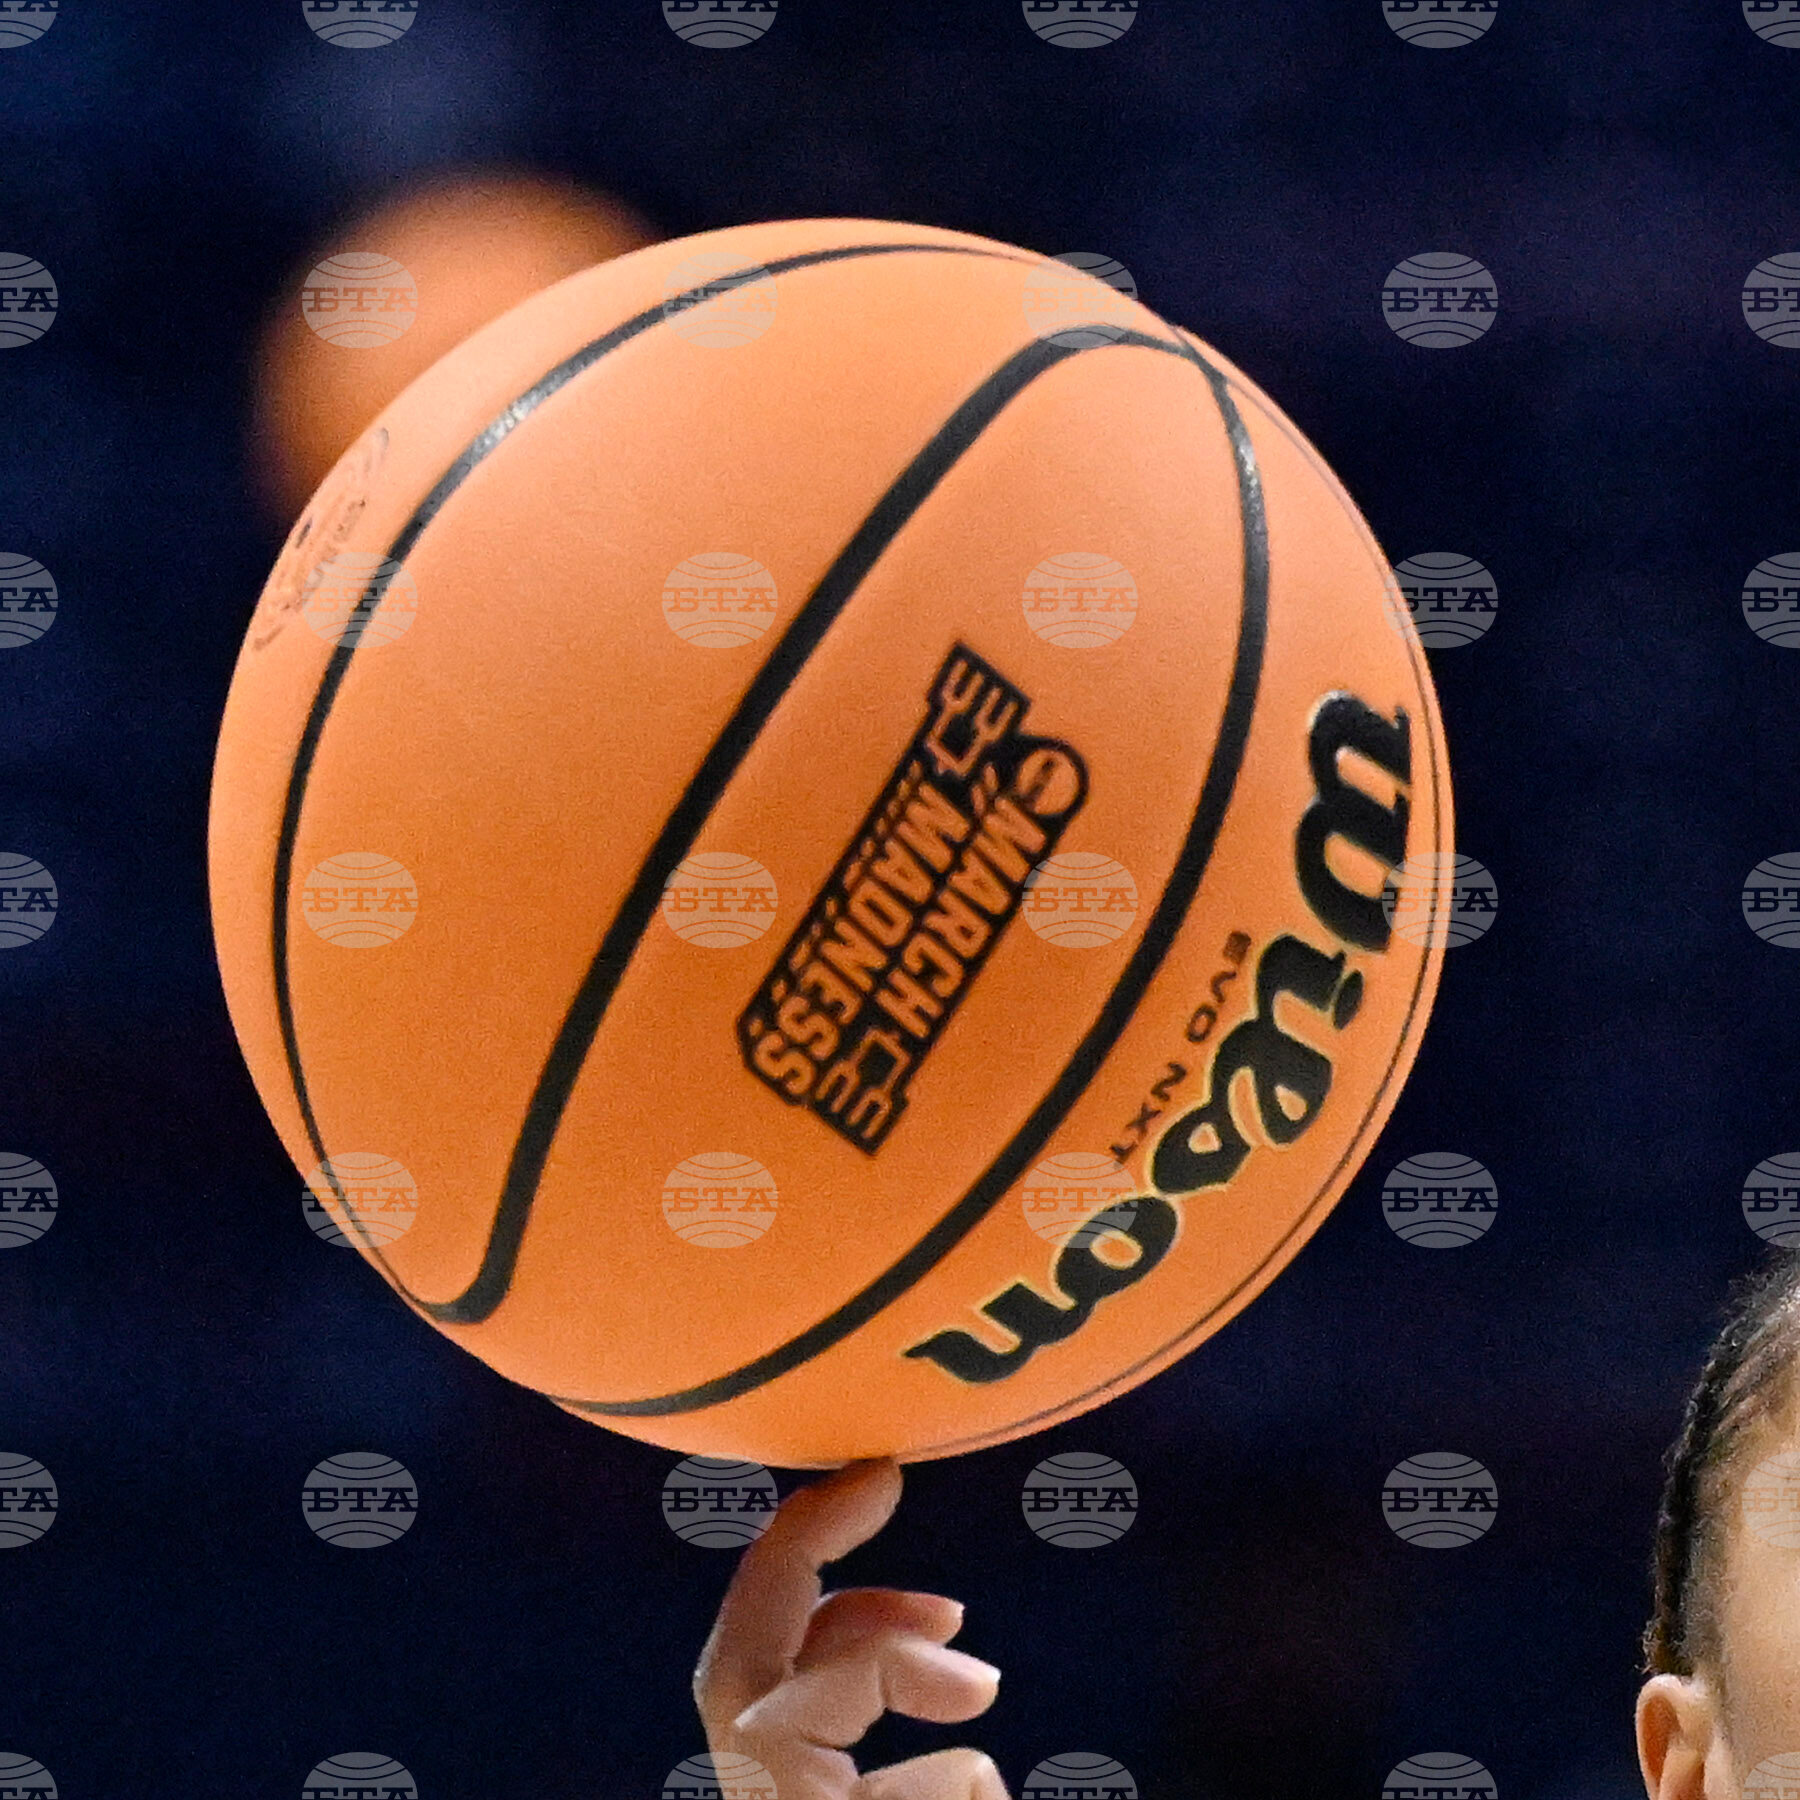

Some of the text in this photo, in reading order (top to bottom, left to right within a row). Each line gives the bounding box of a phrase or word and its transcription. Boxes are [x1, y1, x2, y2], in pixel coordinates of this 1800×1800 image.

[754, 781, 971, 1097] MADNESS
[875, 797, 1047, 1040] MARCH
[904, 689, 1412, 1384] Wilson
[1110, 1062, 1186, 1169] NXT
